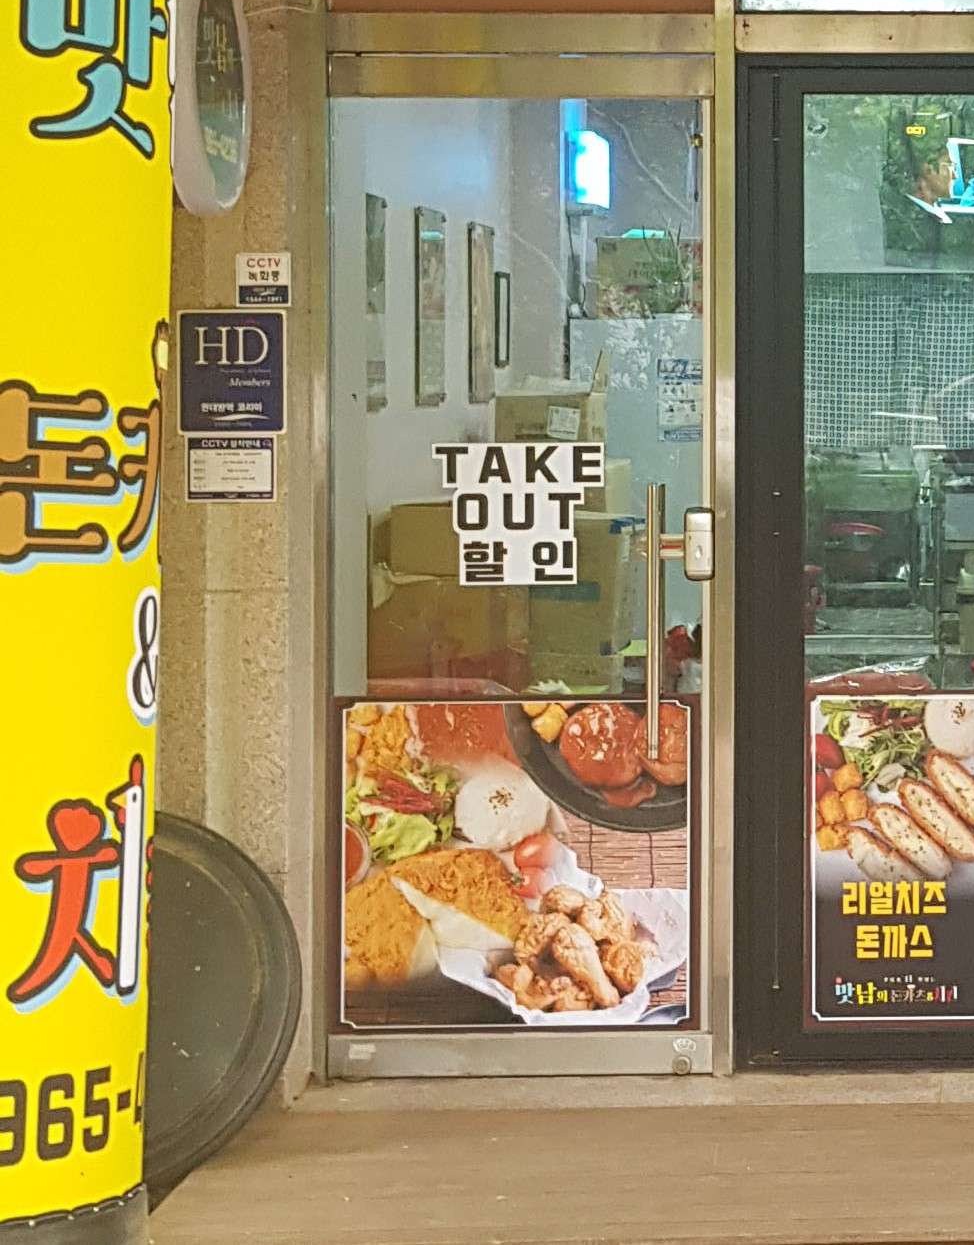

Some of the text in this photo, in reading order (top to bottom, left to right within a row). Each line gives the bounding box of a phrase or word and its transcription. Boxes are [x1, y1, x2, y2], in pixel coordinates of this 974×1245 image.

[246, 258, 281, 268] CCTV
[195, 326, 268, 365] HD
[228, 377, 271, 387] Members
[201, 439, 228, 448] CCTV
[434, 445, 603, 484] TAKE
[456, 492, 583, 531] OUT
[463, 540, 575, 583] 할인
[7, 754, 153, 1004] 치
[842, 881, 947, 915] 리얼치즈
[856, 924, 934, 959] 돈까스
